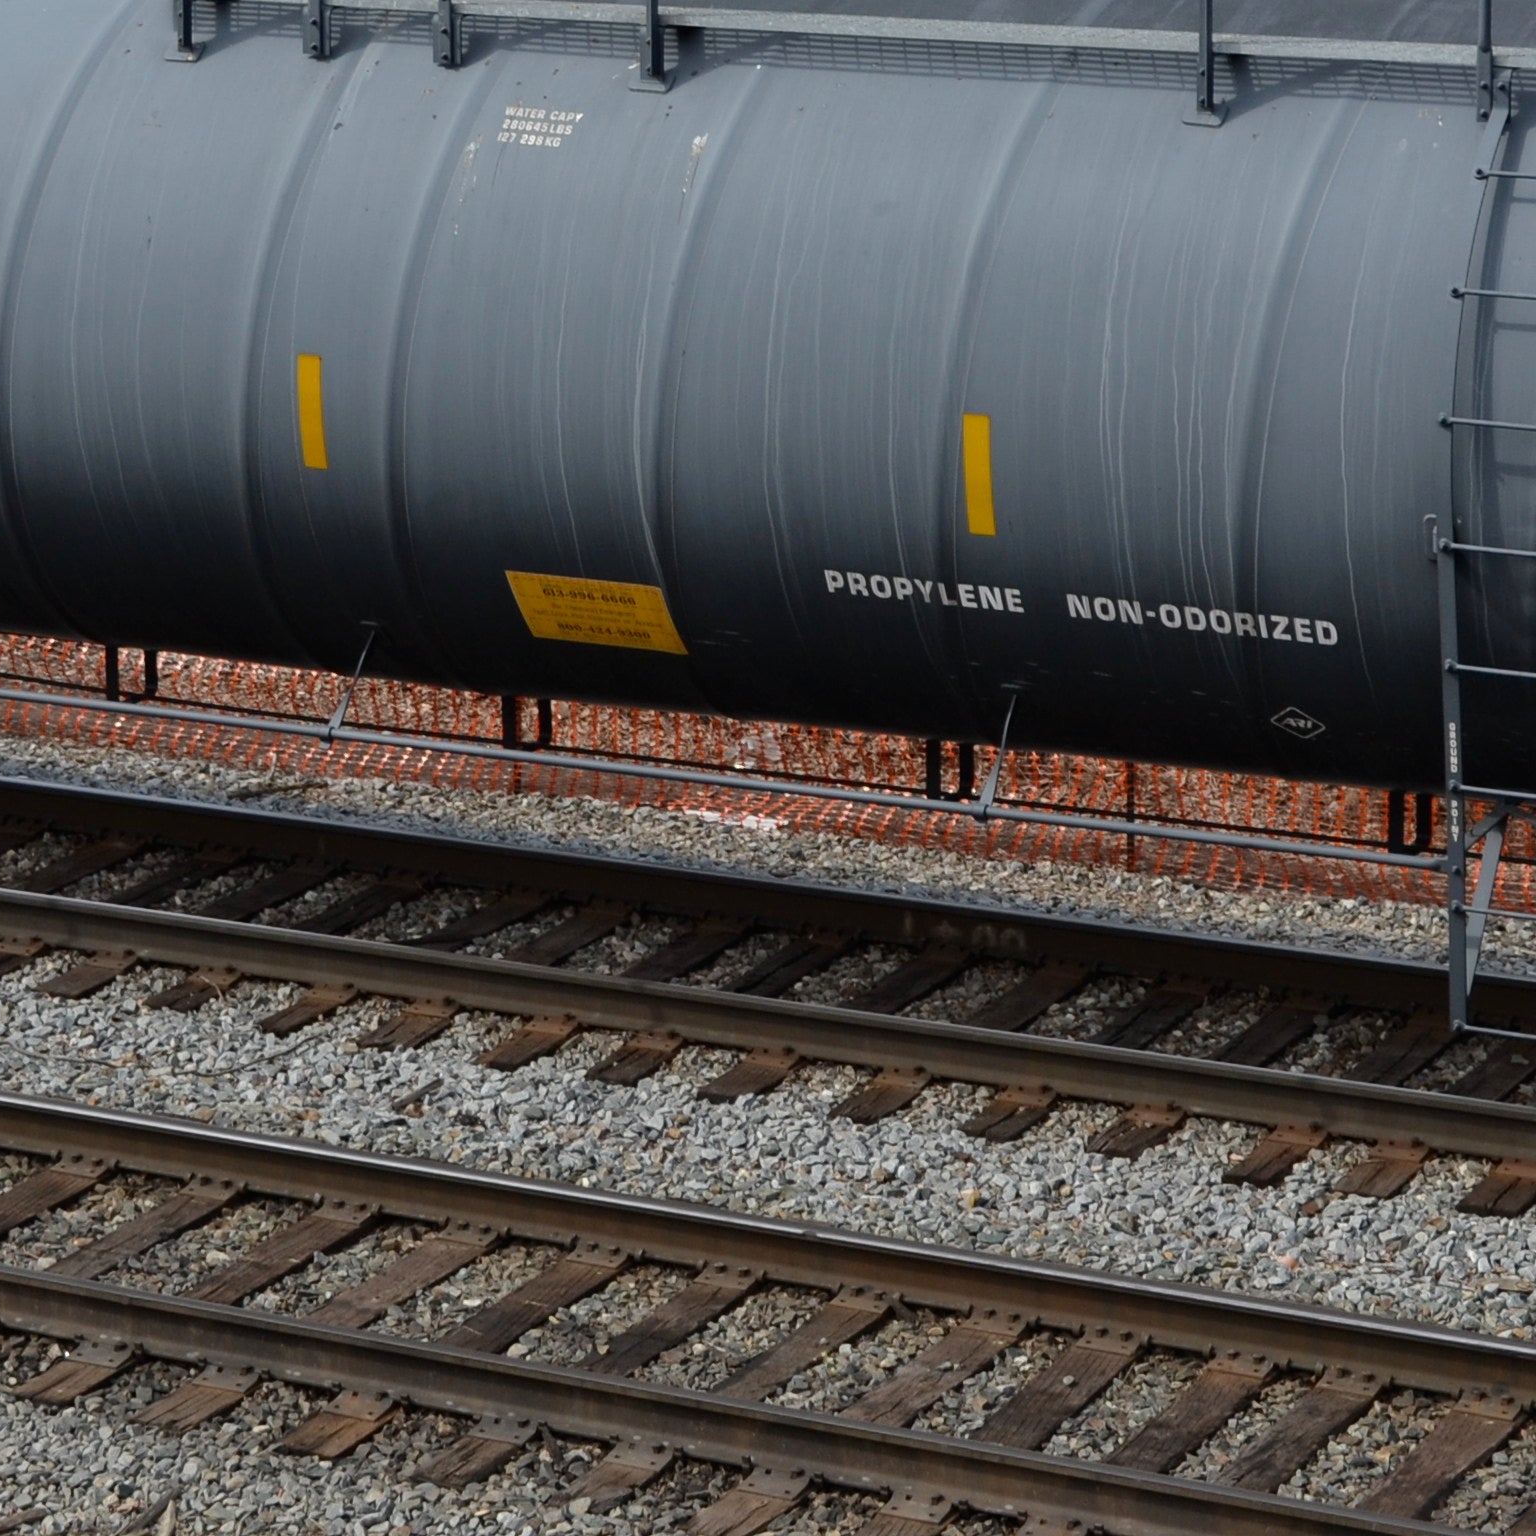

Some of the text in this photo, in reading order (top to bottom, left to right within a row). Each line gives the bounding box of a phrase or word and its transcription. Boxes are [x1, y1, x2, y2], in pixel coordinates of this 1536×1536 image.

[502, 118, 573, 136] 280645 LBS
[505, 106, 584, 123] WATER CAPY
[497, 131, 562, 148] 127 298 KG
[824, 569, 1339, 646] PROPYLENE NON-ODORIZED
[1449, 722, 1458, 773] GROUND
[1450, 799, 1459, 842] POINT
